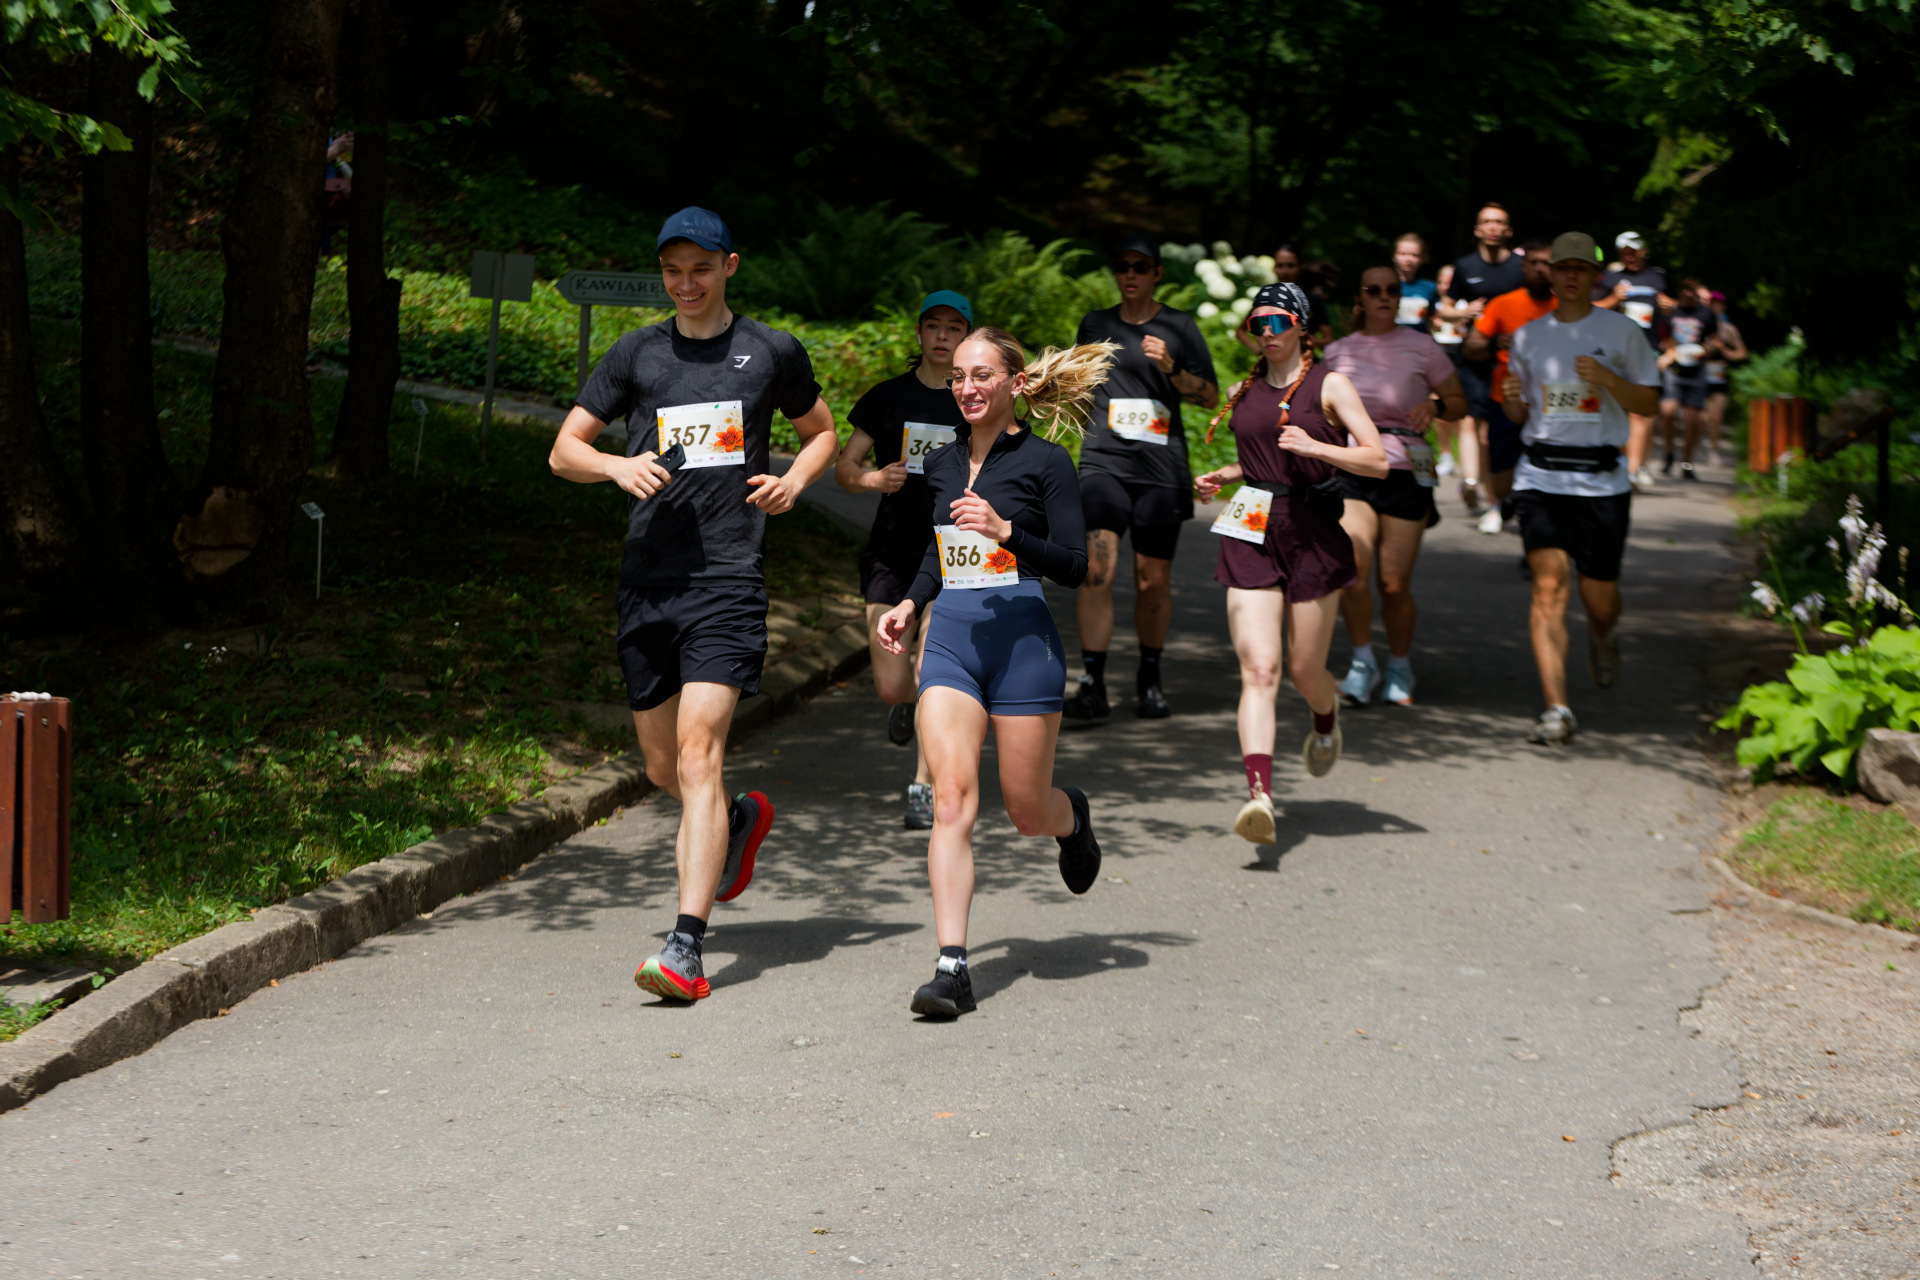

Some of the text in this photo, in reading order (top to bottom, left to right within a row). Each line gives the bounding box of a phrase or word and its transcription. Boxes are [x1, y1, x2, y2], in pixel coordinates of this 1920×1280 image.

[668, 424, 711, 448] 357
[909, 439, 948, 457] 36
[1221, 501, 1245, 519] 18
[946, 545, 981, 567] 356
